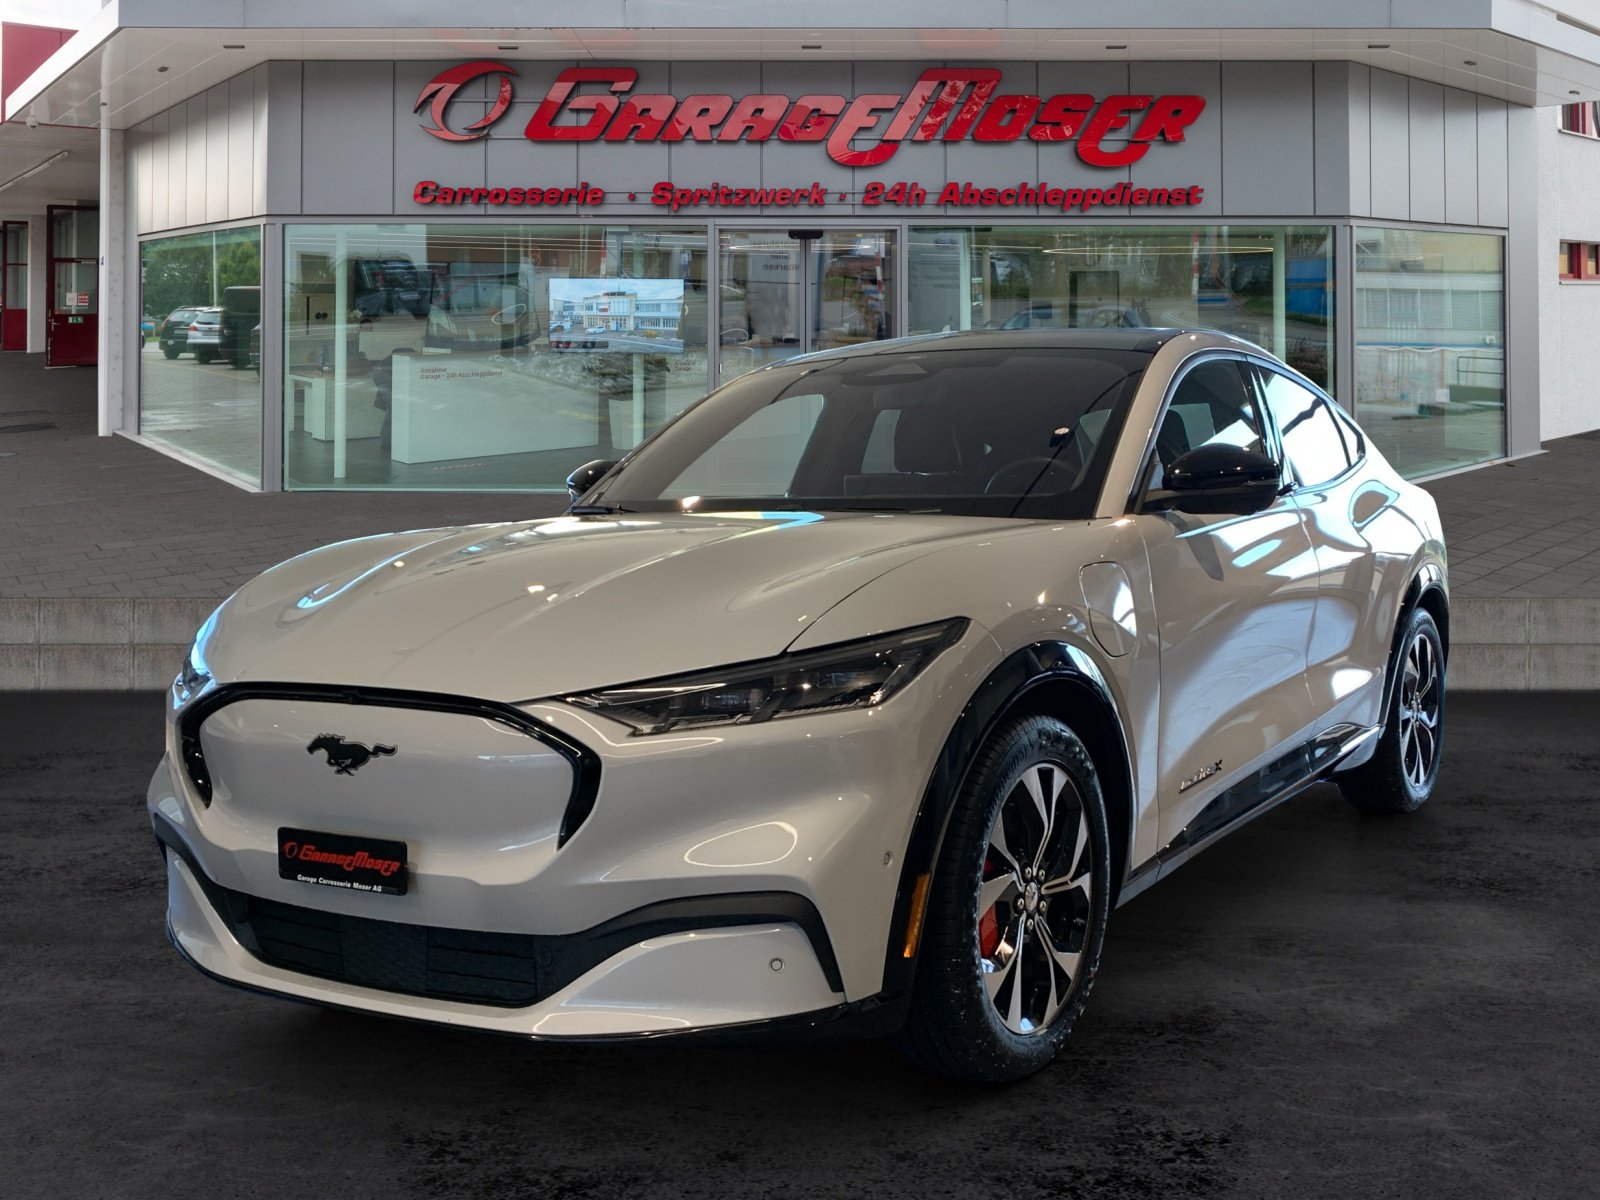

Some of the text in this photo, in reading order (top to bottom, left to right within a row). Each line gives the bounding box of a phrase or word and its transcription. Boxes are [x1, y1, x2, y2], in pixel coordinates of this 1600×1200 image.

[413, 181, 1204, 212] Carrosserie Spritzwerk 24h Abschleppdienst
[297, 874, 317, 883] Garage
[318, 877, 351, 888] Carrosserie
[353, 882, 372, 891] Moser
